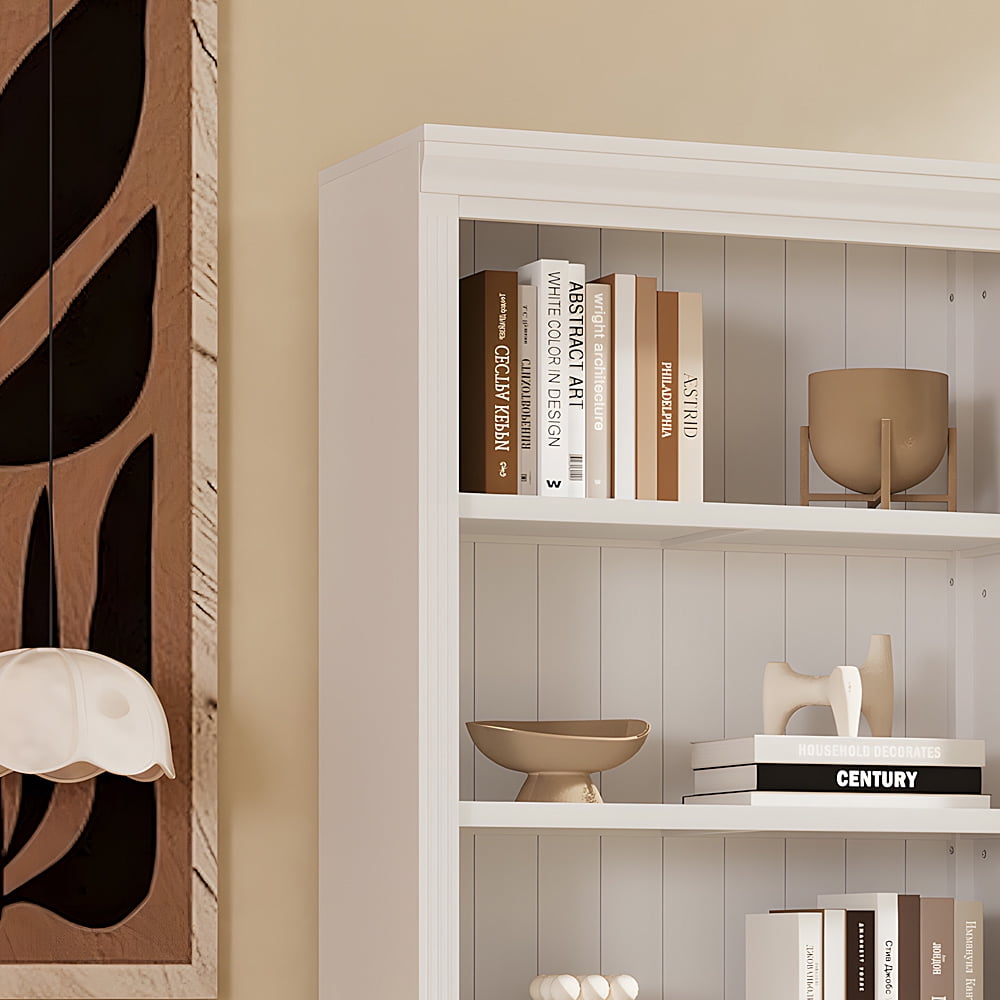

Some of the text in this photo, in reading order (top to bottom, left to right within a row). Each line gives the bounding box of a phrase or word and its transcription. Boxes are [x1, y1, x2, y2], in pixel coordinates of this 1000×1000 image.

[548, 272, 560, 447] WHITE COLOR IN DESIGN
[569, 282, 583, 409] ABSTRACT ART
[592, 293, 606, 431] wright architecture
[662, 362, 672, 438] PHILADELPHIA
[798, 744, 870, 757] HOUSEHOLD
[836, 770, 917, 788] CENTURY
[884, 963, 893, 994] Джобс
[964, 921, 976, 974] Иммануил
